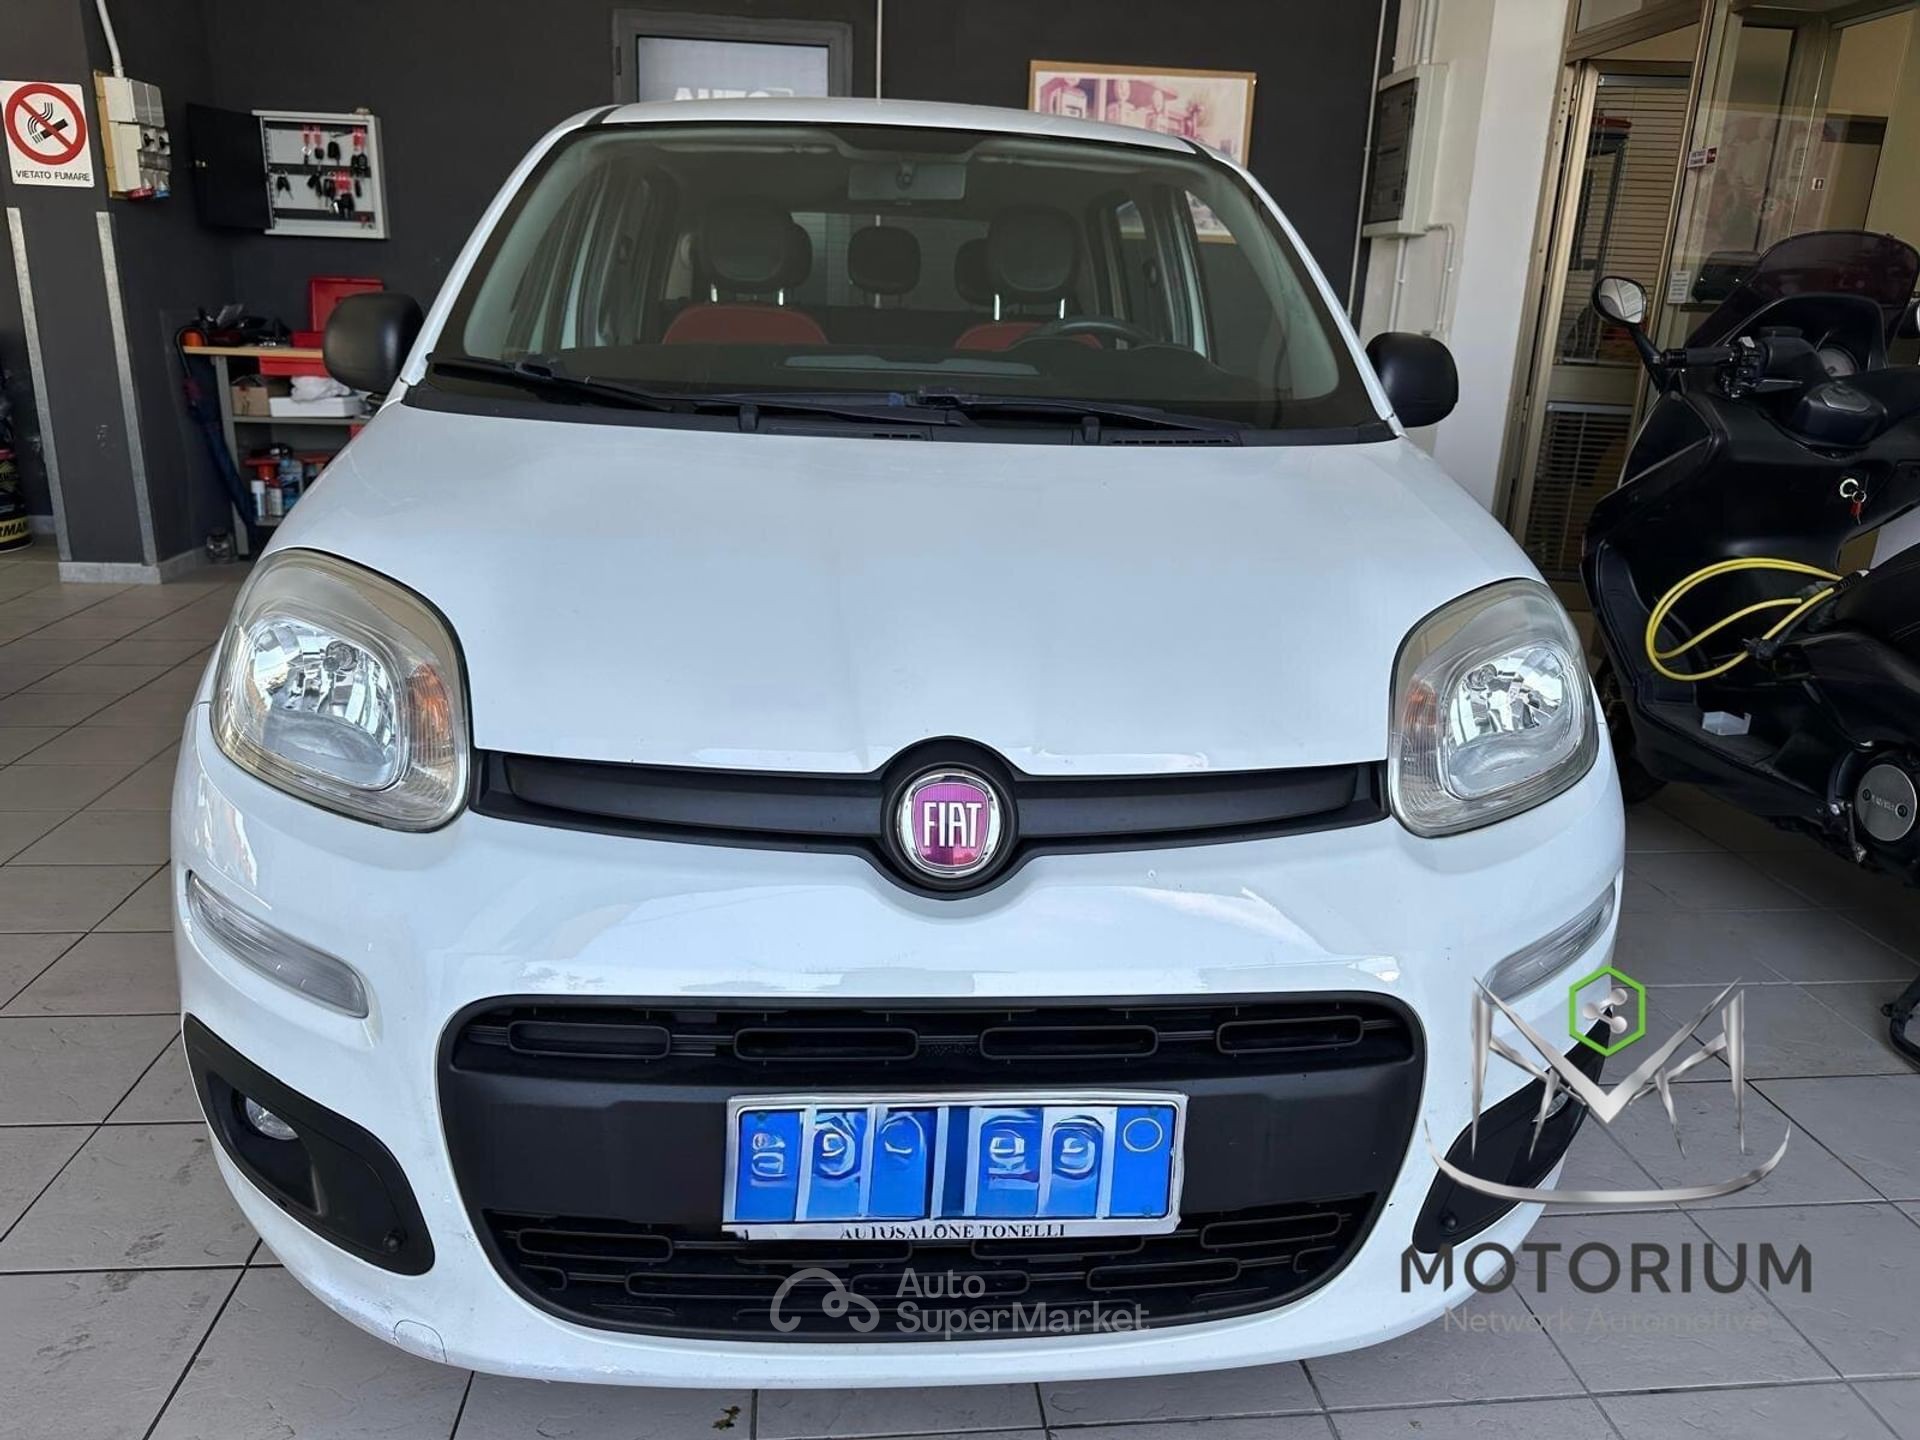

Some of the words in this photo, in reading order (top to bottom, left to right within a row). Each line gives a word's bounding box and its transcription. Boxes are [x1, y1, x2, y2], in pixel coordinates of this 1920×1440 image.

[16, 170, 52, 179] VIETATO
[54, 171, 90, 181] FUMARE
[923, 801, 982, 848] FIAT
[979, 1223, 1065, 1239] TONELLI
